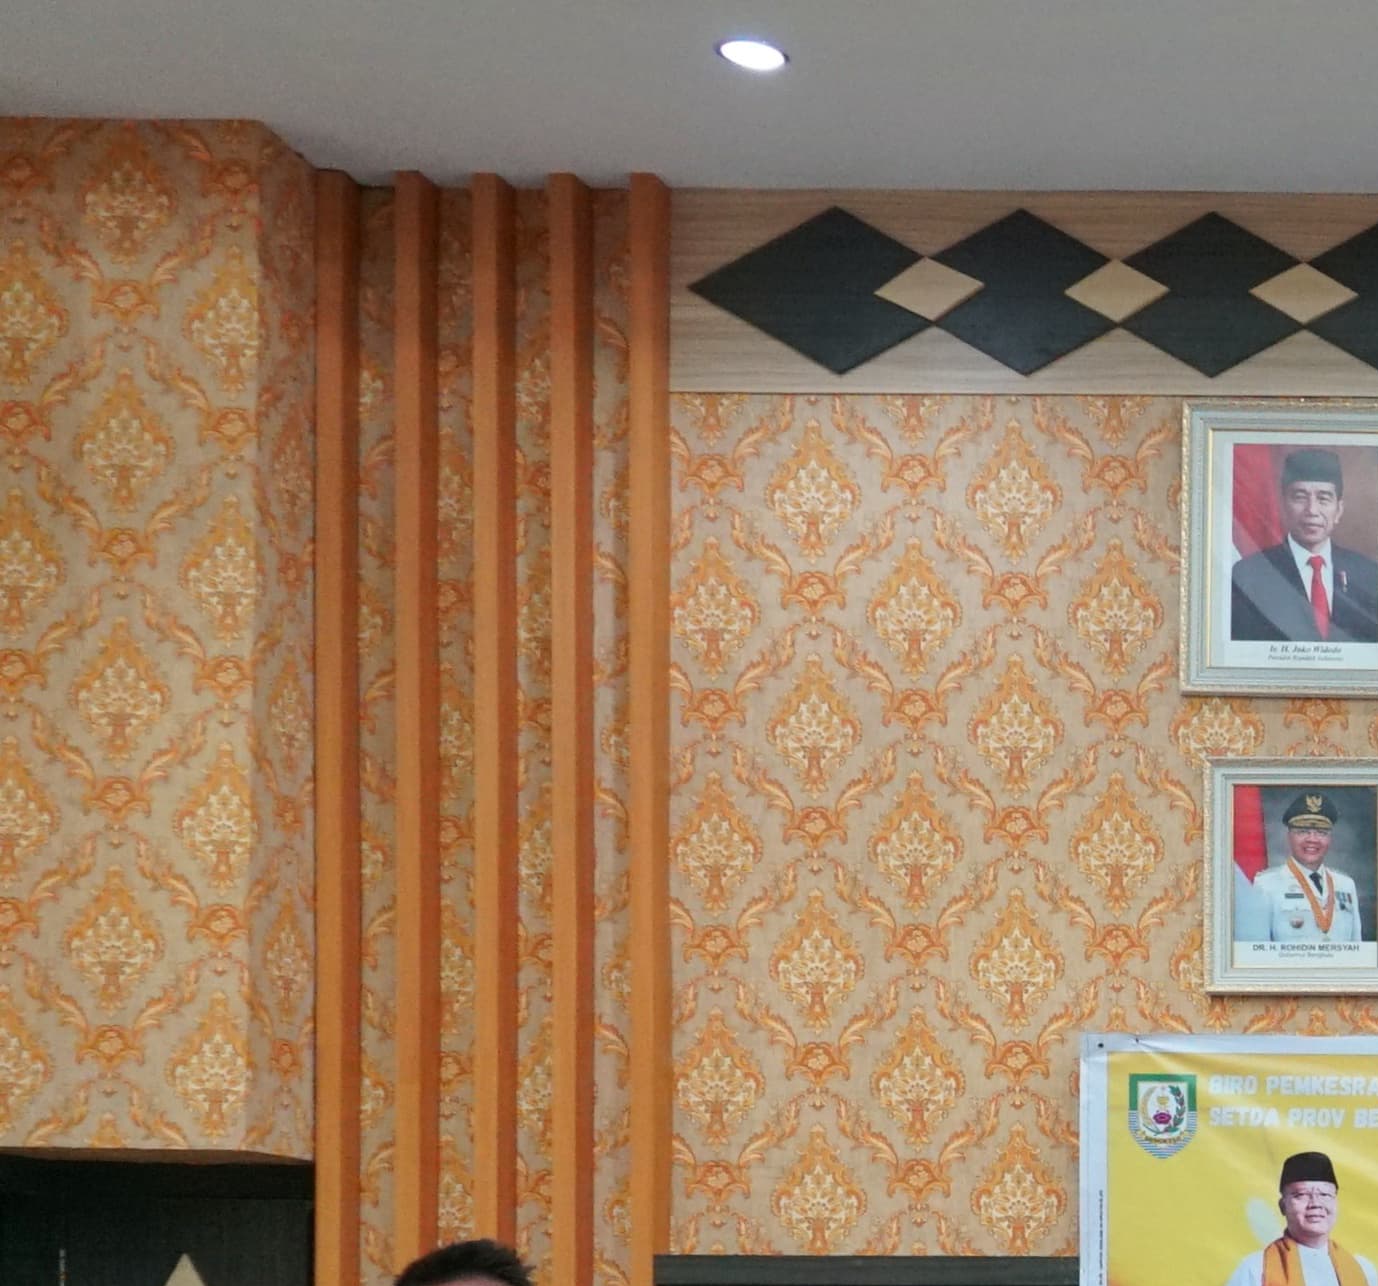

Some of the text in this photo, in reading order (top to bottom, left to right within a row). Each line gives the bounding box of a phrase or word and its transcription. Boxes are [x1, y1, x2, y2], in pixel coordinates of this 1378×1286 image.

[1208, 1075, 1258, 1096] BIRO
[1209, 1107, 1280, 1127] SETDA
[1287, 1108, 1345, 1128] PROV
